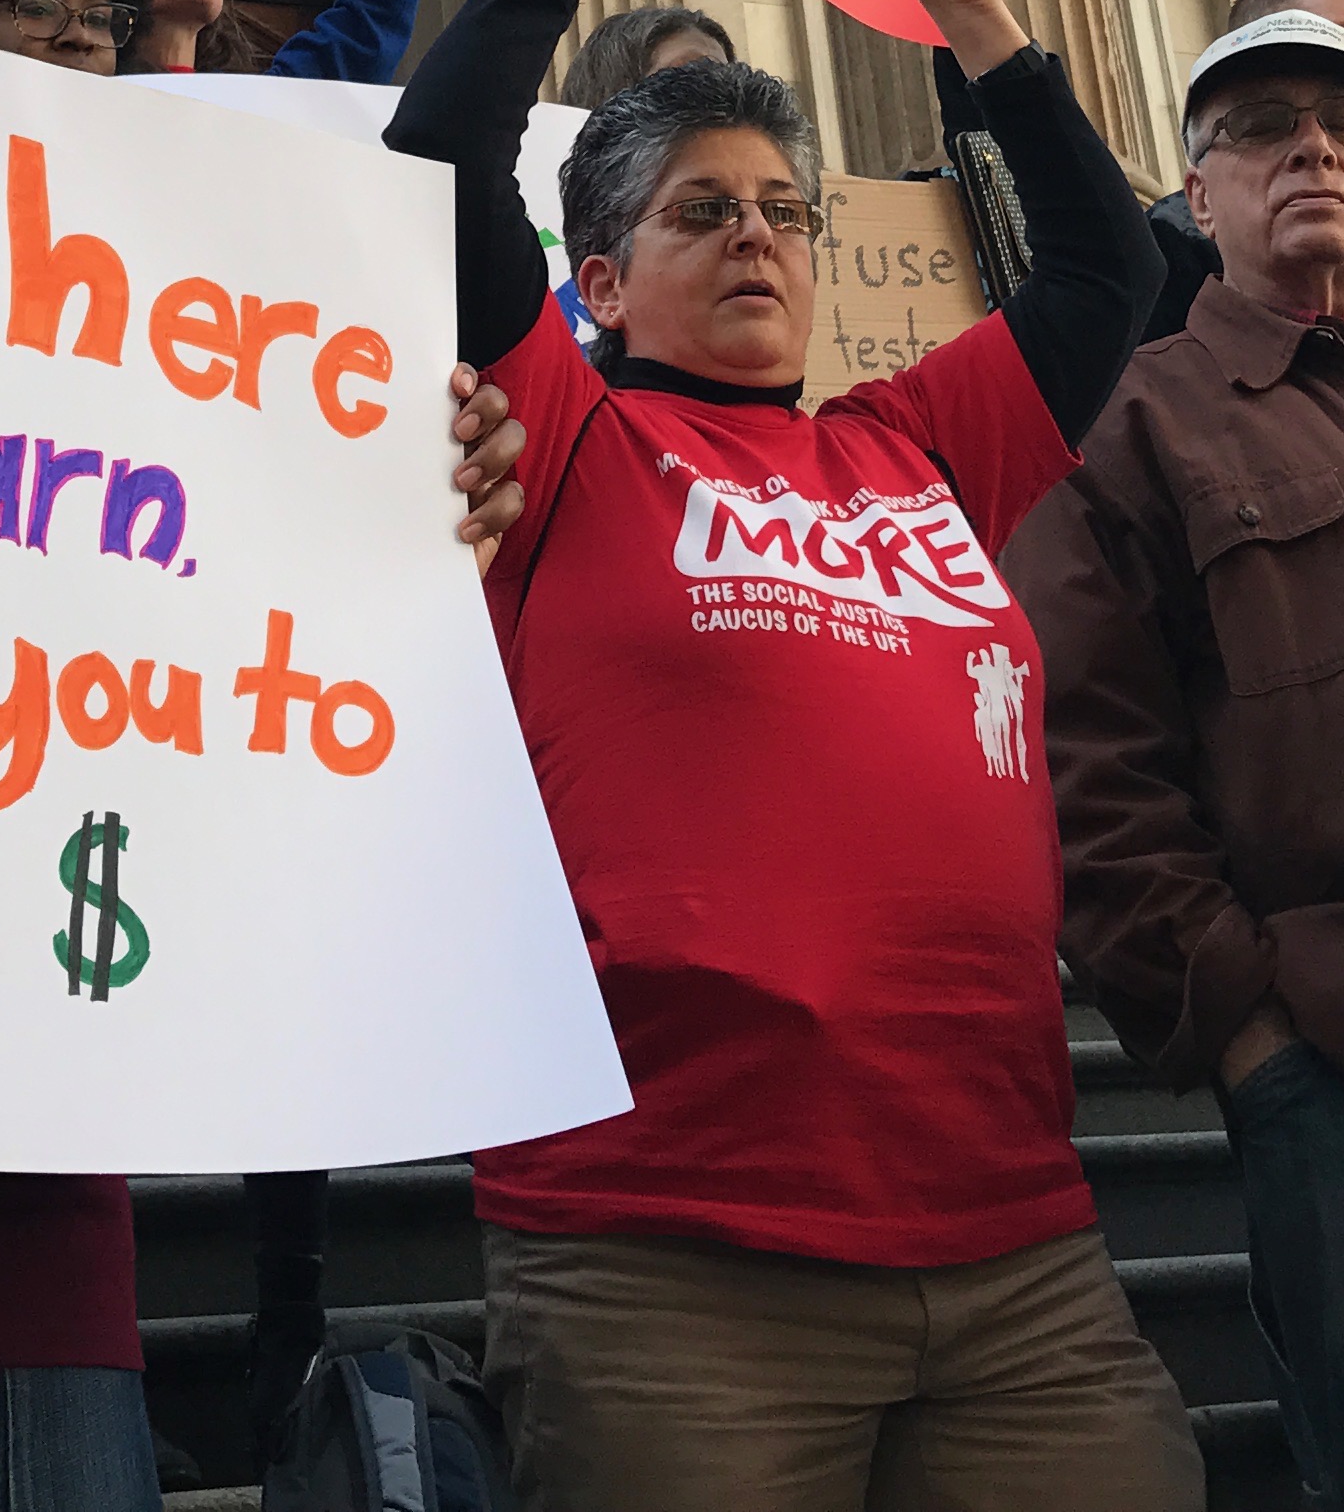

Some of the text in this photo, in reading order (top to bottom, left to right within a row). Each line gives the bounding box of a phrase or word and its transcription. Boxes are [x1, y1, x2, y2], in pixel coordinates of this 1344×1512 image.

[6, 134, 393, 439] here
[704, 496, 988, 601] MORE
[834, 504, 848, 519] &
[686, 581, 910, 635] THE SOCIAL JUSTICE
[691, 608, 912, 656] CAUCUS OF THE UFT
[233, 608, 395, 777] to
[52, 810, 151, 1003] $
